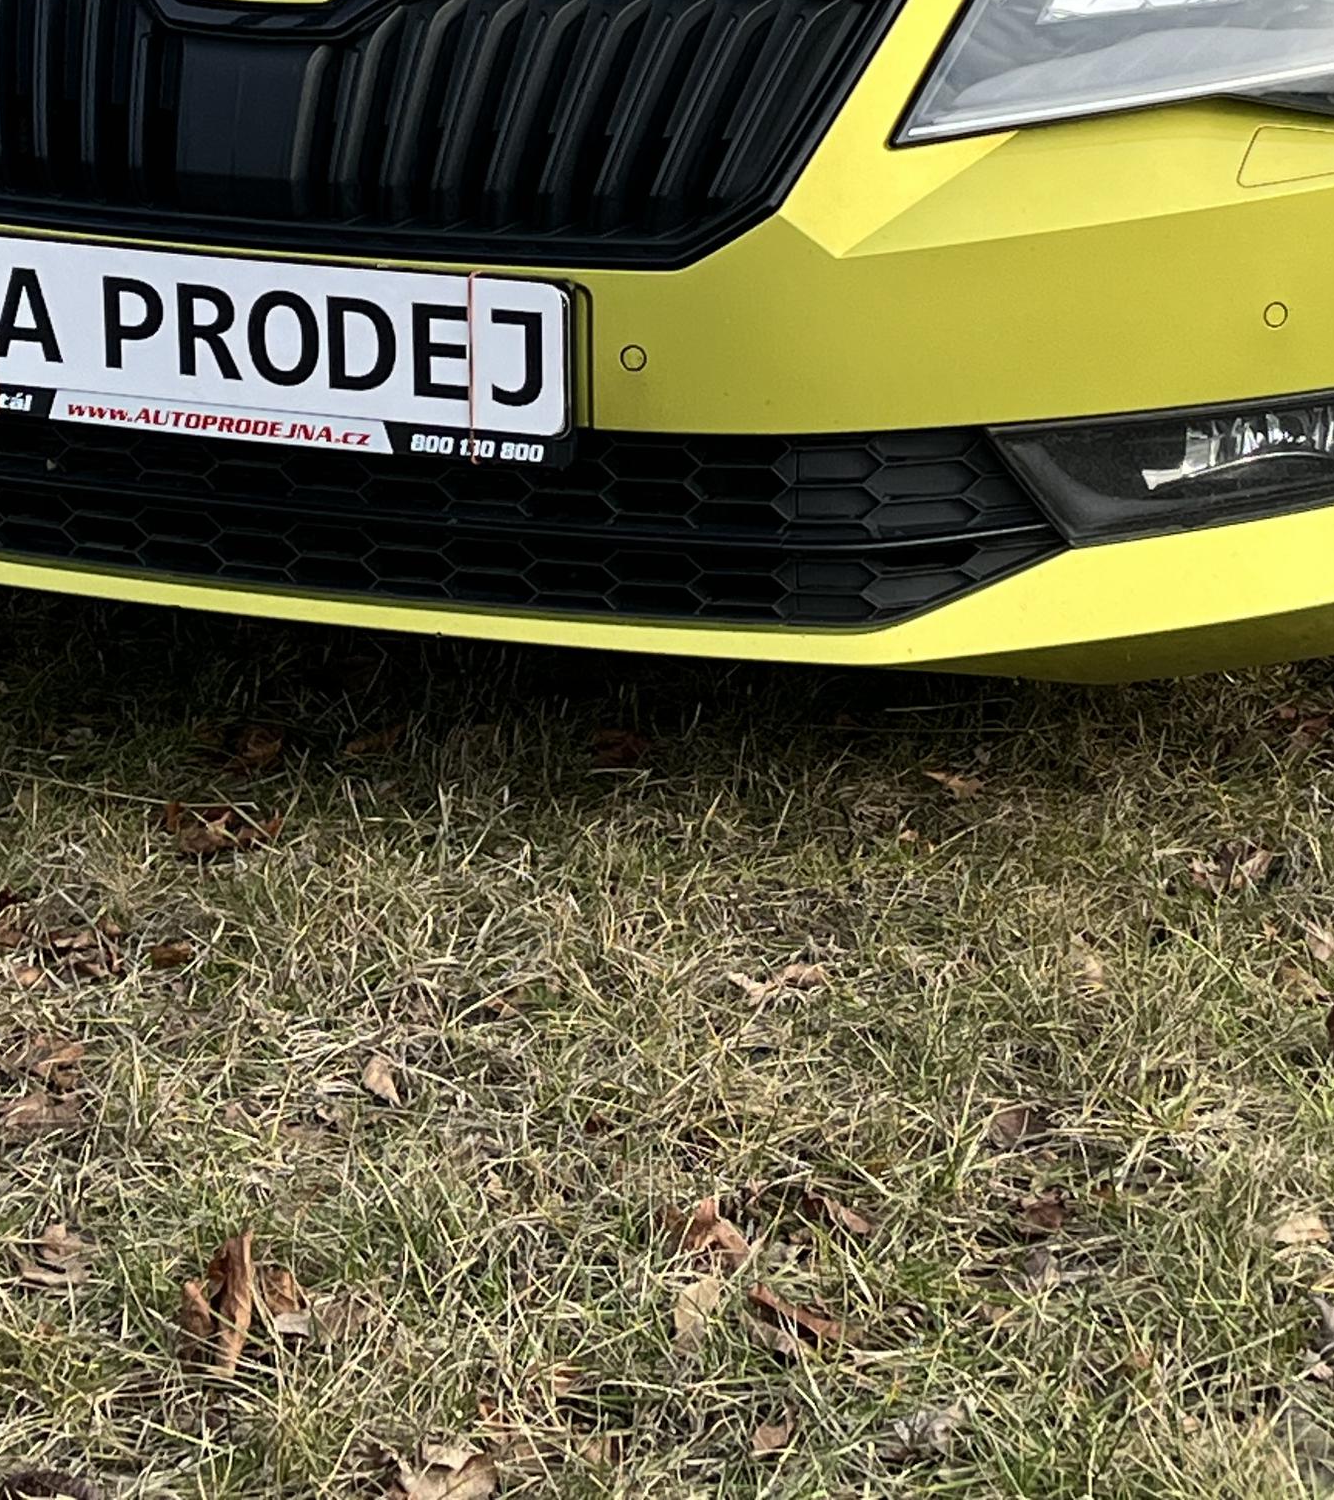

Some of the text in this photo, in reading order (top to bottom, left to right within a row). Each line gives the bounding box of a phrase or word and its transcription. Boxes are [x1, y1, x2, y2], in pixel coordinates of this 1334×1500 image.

[102, 275, 545, 407] PRODEJ
[68, 402, 372, 446] www.AUTOPRODEJNA.cz
[411, 434, 454, 455] 800
[500, 442, 545, 463] 800
